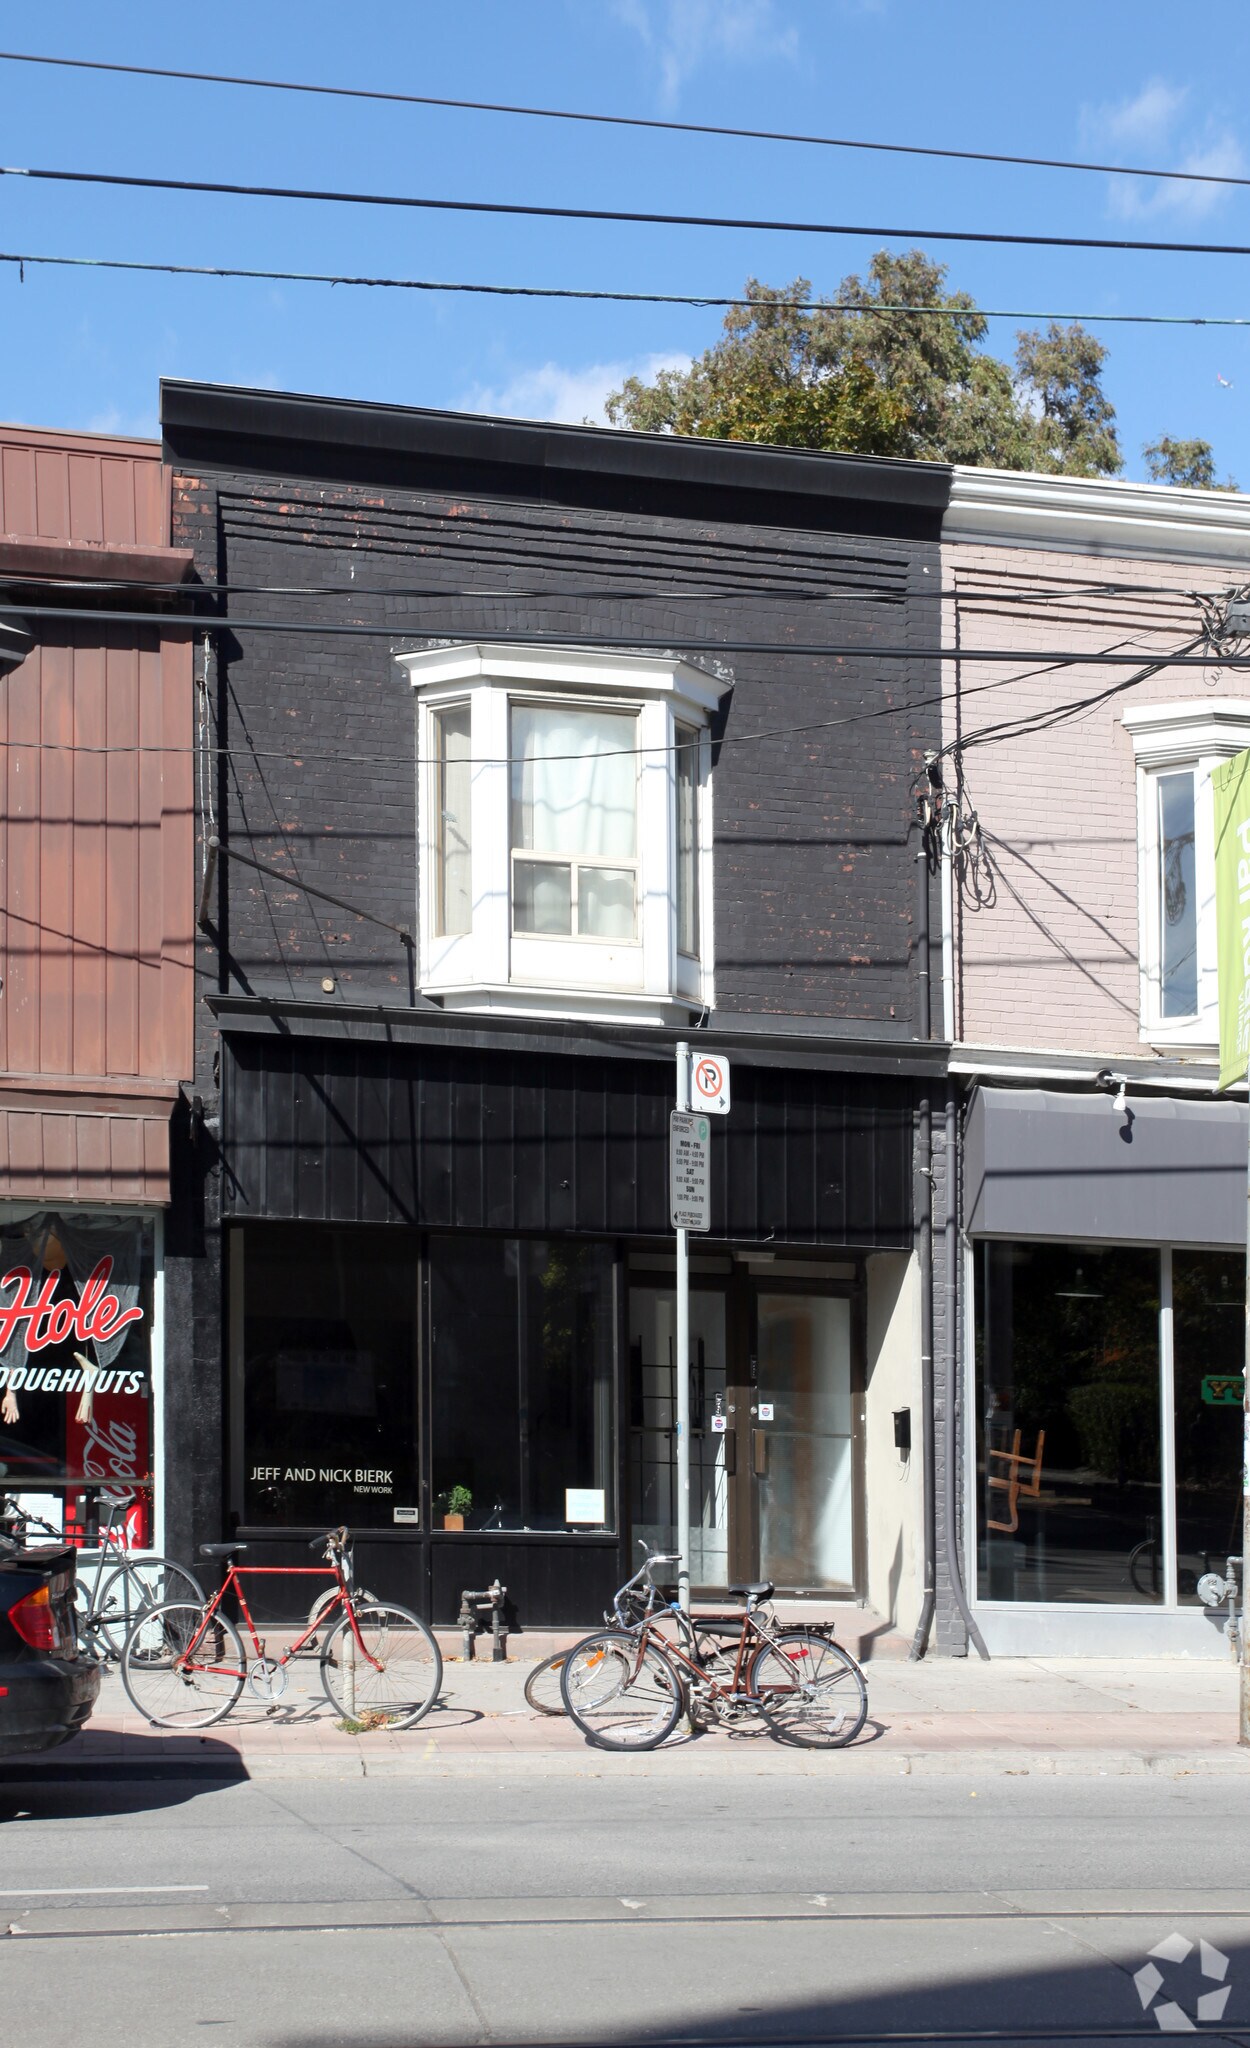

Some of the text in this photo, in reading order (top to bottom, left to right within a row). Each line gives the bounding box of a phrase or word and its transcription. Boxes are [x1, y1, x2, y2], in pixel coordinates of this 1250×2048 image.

[680, 1140, 690, 1148] MON
[0, 1254, 144, 1353] Hole
[250, 1467, 393, 1483] JEFF AND NICK BIERK
[371, 1486, 393, 1494] WORK
